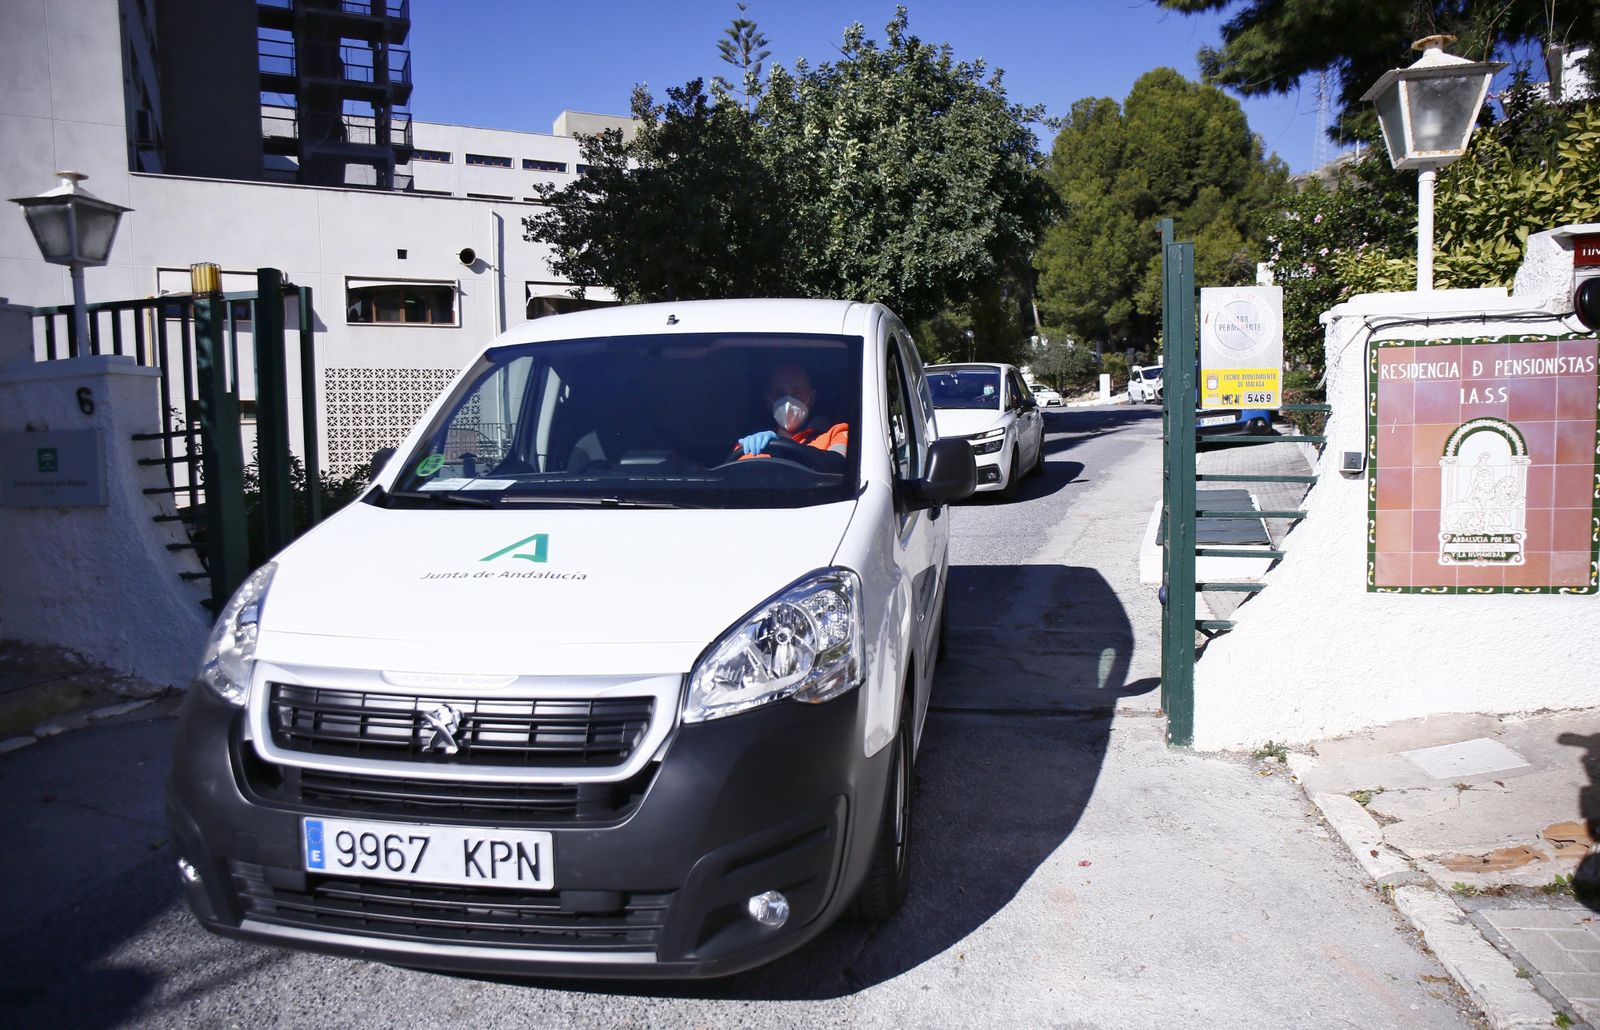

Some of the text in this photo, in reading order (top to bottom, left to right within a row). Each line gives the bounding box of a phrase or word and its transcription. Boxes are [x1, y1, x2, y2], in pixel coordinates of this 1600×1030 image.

[1218, 323, 1261, 331] PERMNENTE
[1381, 361, 1460, 379] RESIDENCIA
[1495, 356, 1595, 376] PENSIONISTAS
[76, 386, 95, 415] 6
[1247, 393, 1272, 403] 5469
[420, 570, 588, 580] Junta de Andalucía
[312, 830, 541, 882] E 9967 KPN
